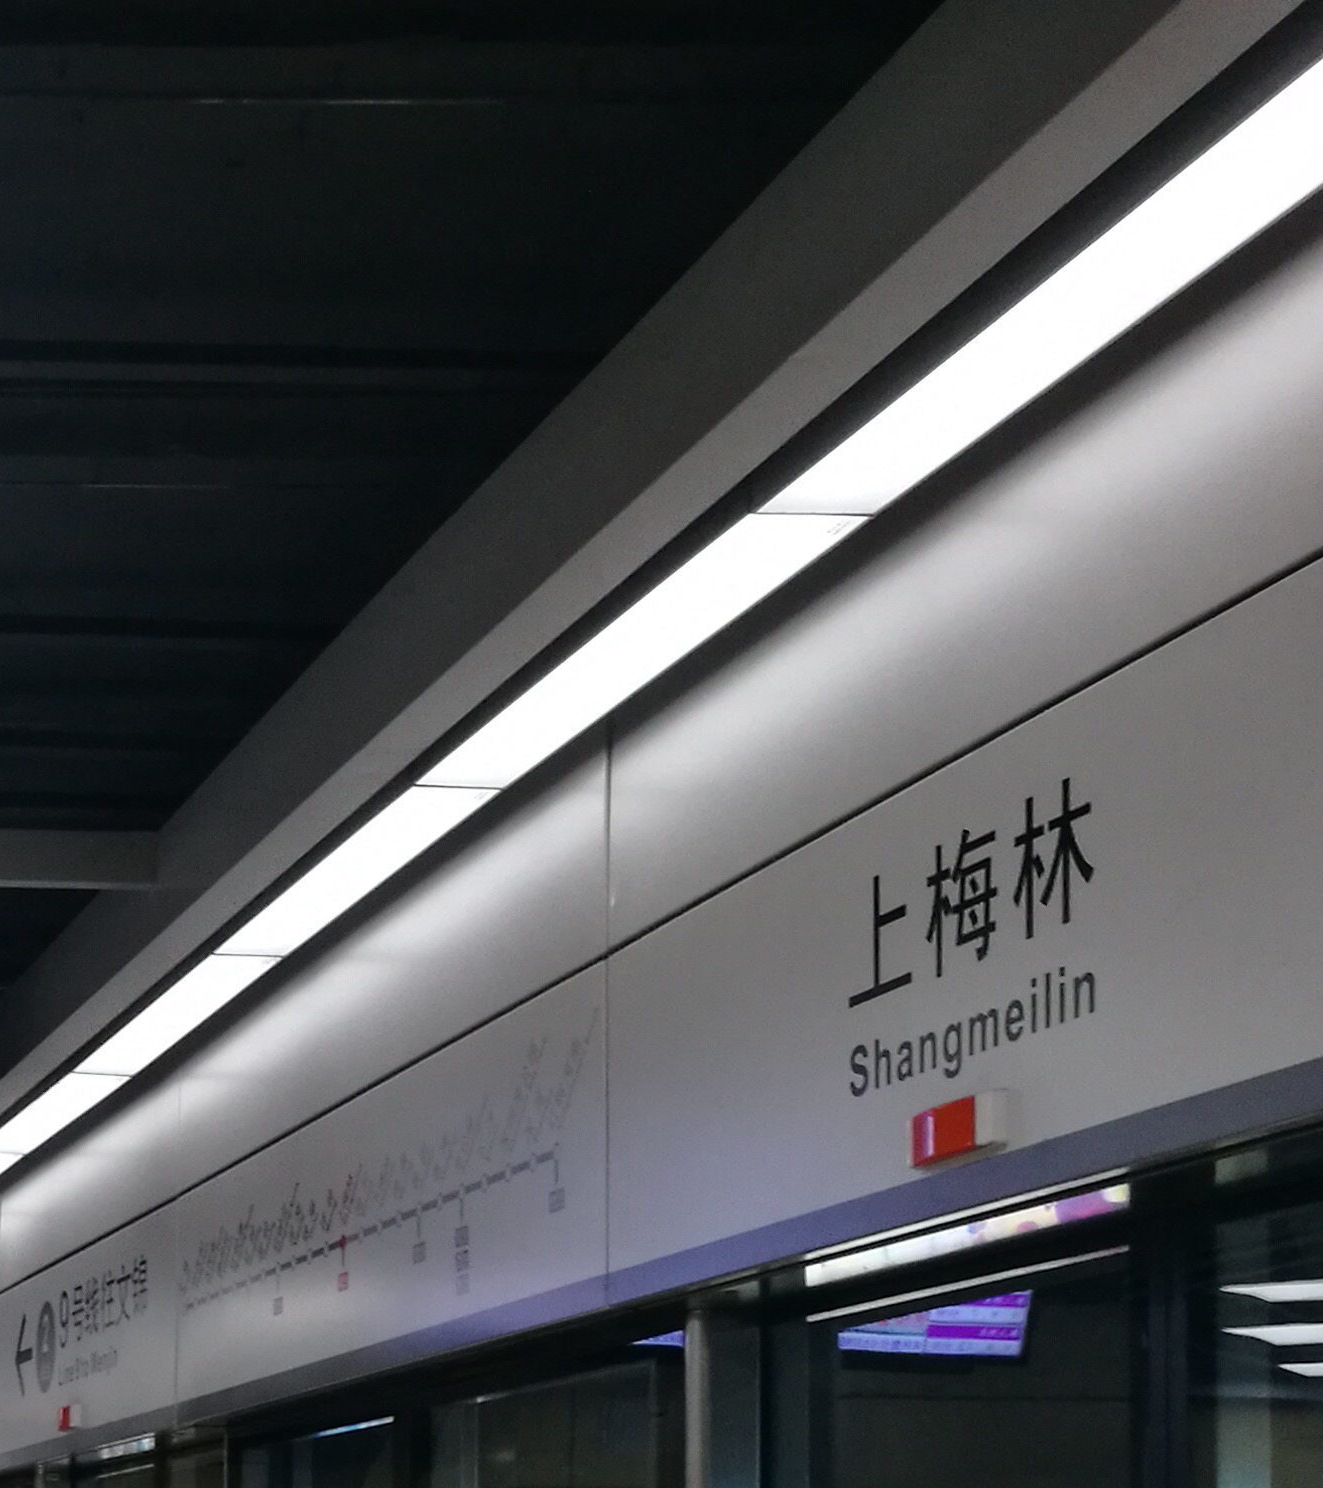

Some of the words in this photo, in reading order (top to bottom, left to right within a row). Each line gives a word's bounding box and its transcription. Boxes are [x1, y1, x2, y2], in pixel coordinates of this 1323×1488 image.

[848, 778, 1095, 1008] 上梅林
[849, 966, 1096, 1097] Shangmeilin
